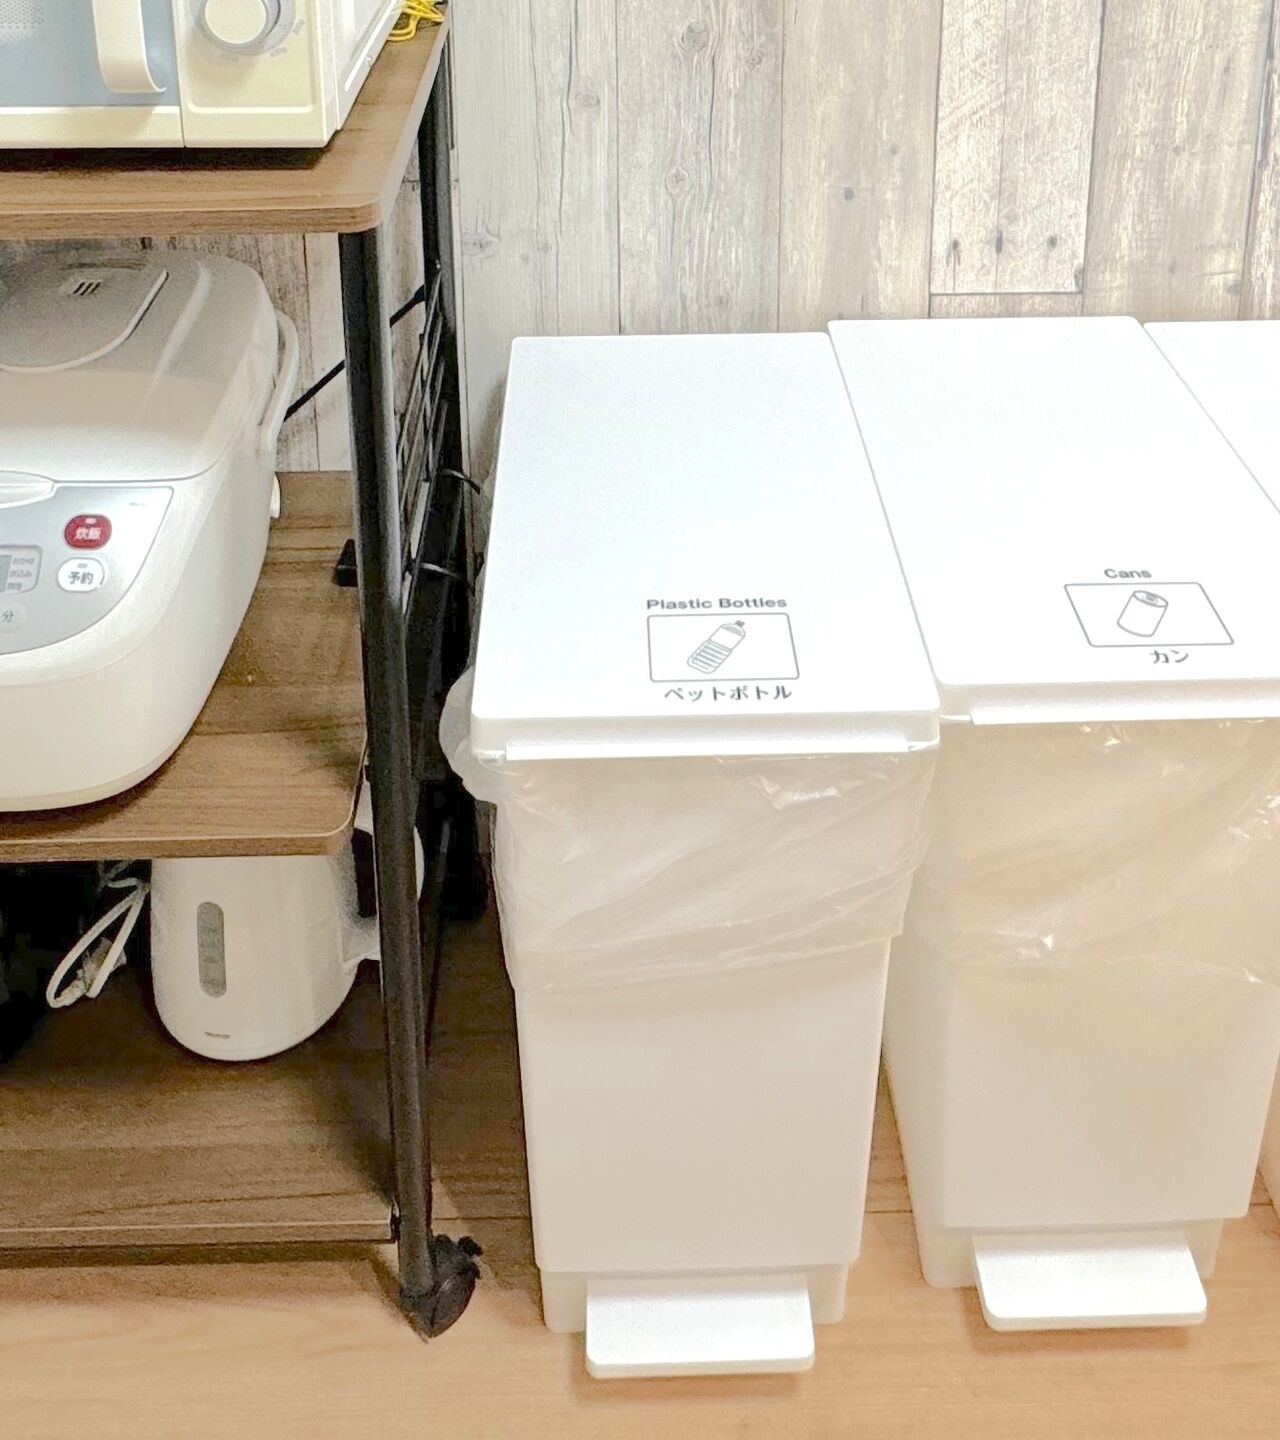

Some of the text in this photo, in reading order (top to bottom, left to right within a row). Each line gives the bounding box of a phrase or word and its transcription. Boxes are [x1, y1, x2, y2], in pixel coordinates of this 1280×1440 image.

[73, 527, 103, 541] 炊飯
[68, 570, 95, 586] 予約
[1103, 567, 1153, 580] Cans
[646, 596, 788, 611] Plastic Bottles
[1, 609, 15, 624] 分
[1149, 649, 1191, 665] カン
[664, 684, 793, 703] ペットボトル
